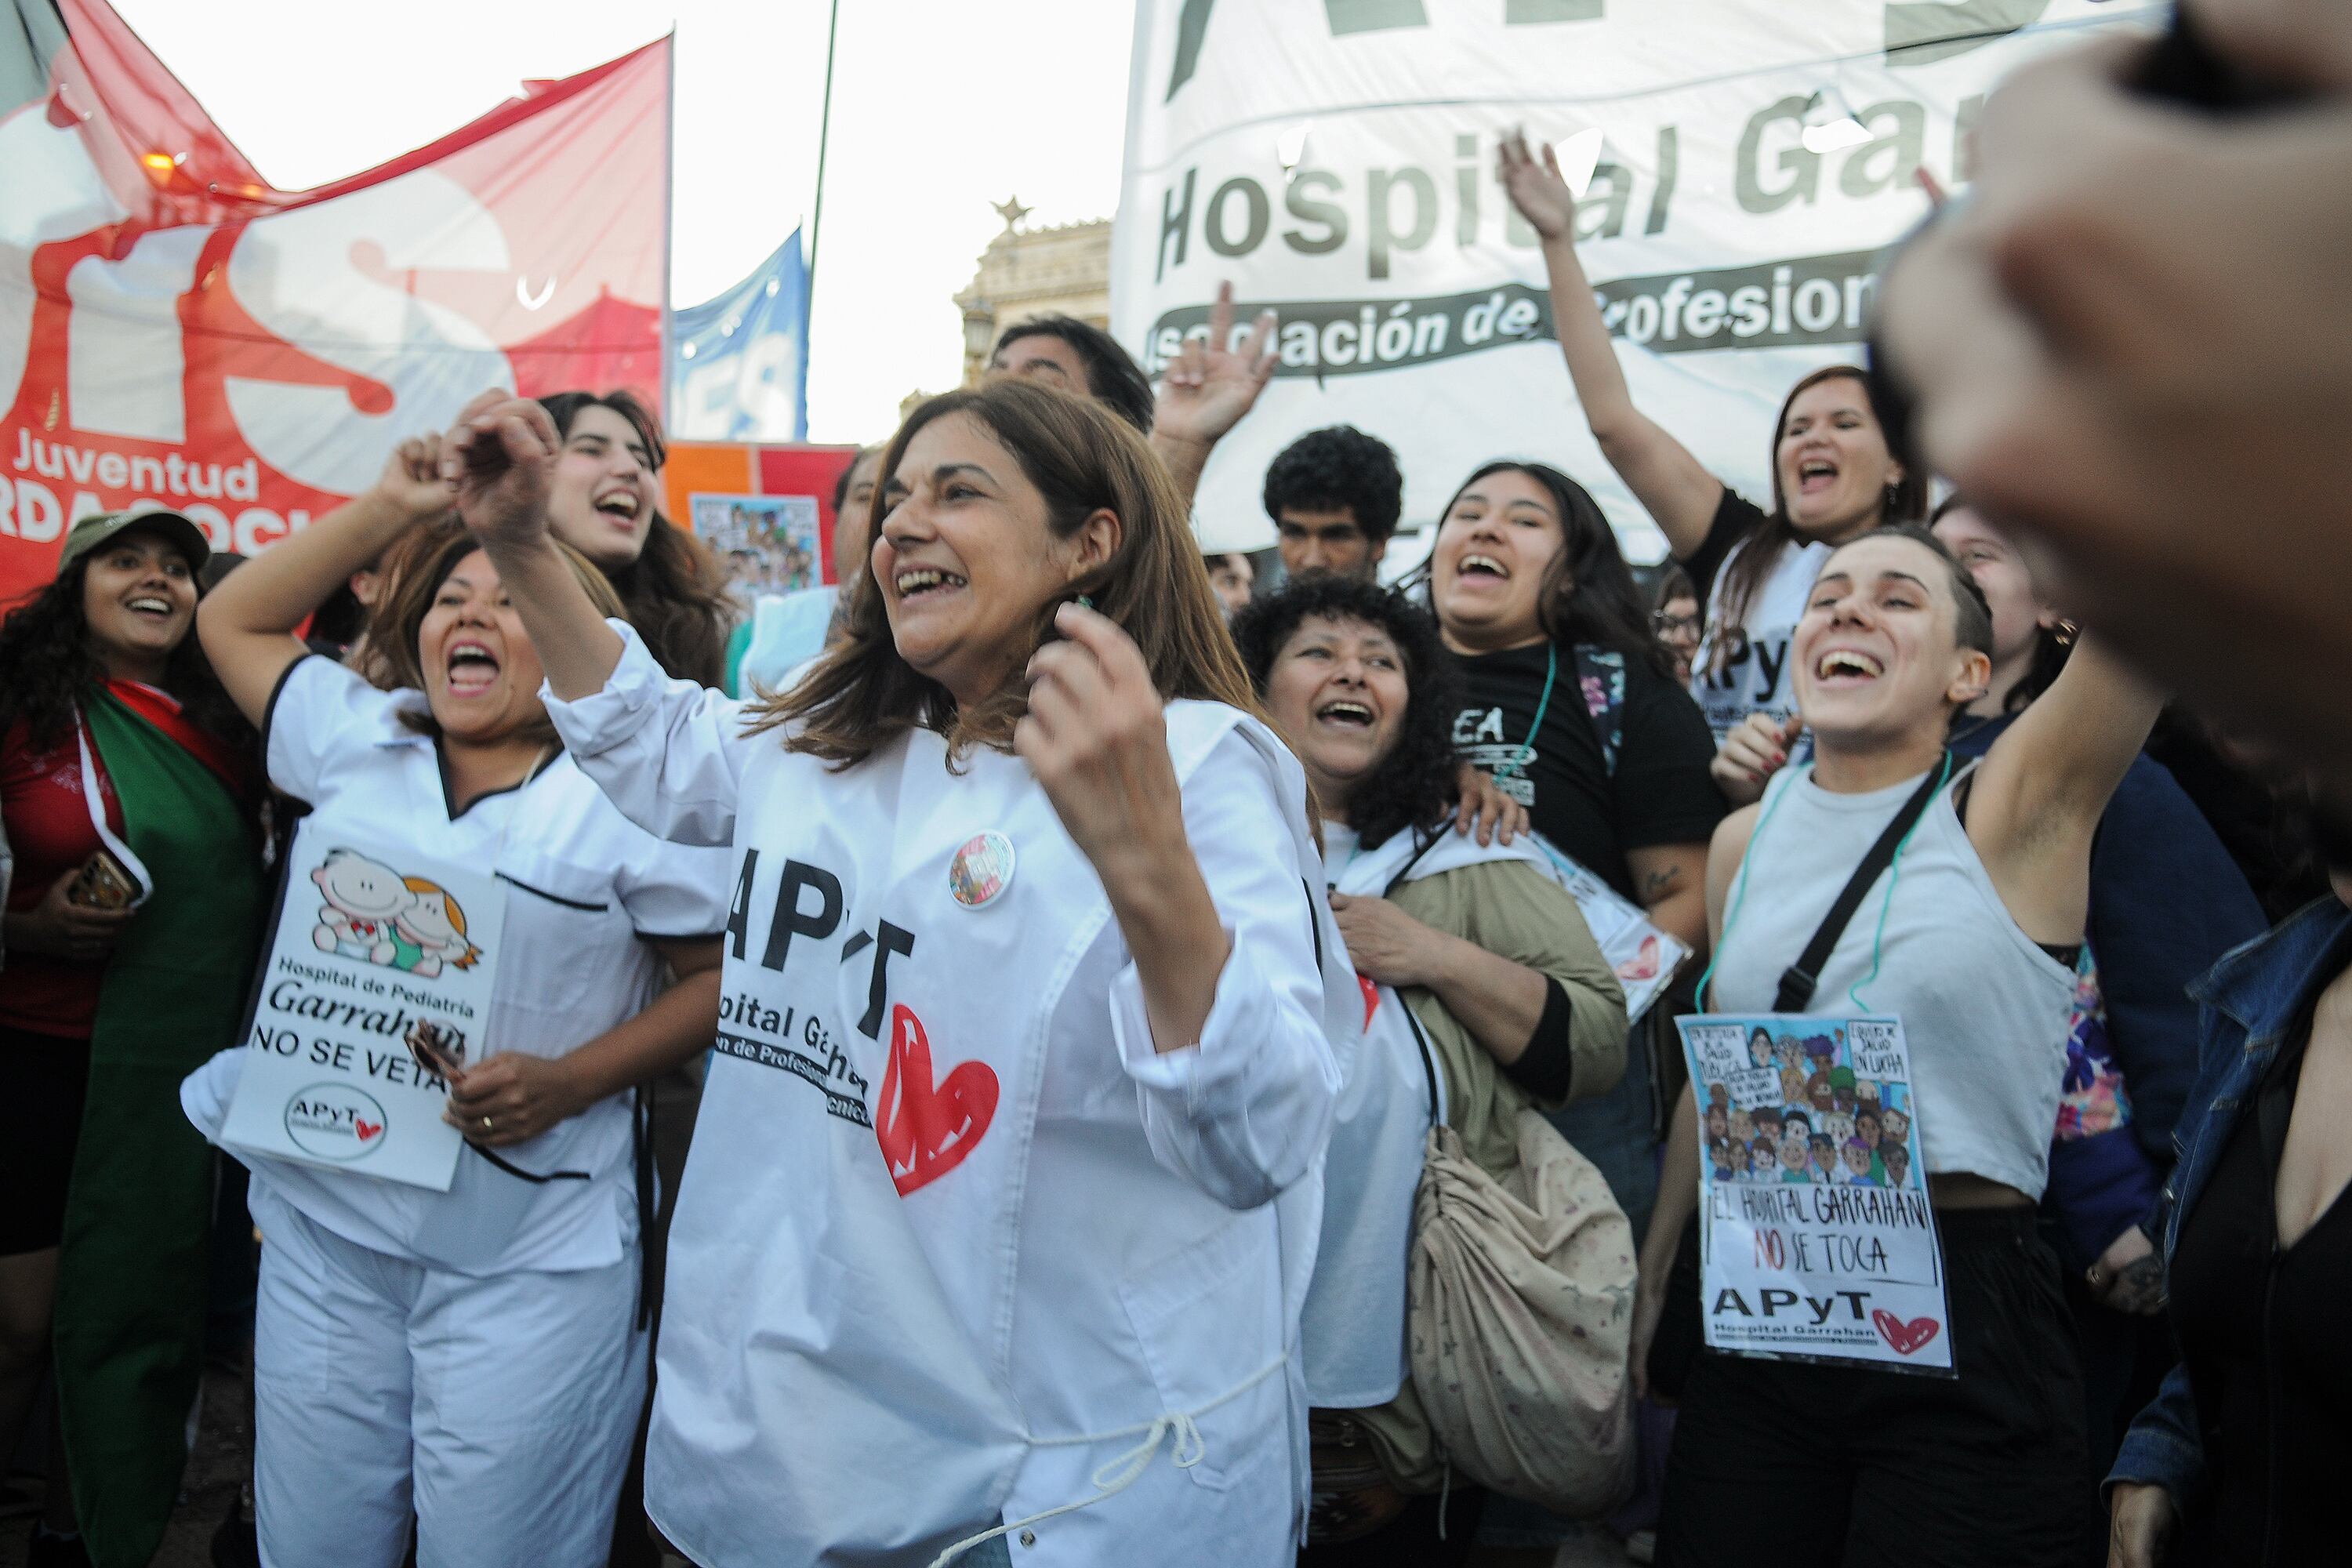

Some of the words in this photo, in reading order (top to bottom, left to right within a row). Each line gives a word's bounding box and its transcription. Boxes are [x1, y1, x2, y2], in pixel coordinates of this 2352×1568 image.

[1156, 125, 1677, 283] Hospial
[1461, 290, 1540, 346] de
[1593, 266, 1878, 344] rofesion
[13, 426, 260, 502] Juventud
[278, 956, 356, 989] Hospital
[363, 978, 386, 995] de
[252, 1023, 299, 1057] NO
[310, 1038, 355, 1072] SE
[366, 1048, 447, 1094] VETA
[733, 1040, 757, 1058] de
[293, 1098, 359, 1124] APyT
[1715, 1185, 1734, 1221] EL
[1813, 1186, 1927, 1230] GARRAHAN
[1754, 1229, 1786, 1271] NO
[1791, 1232, 1814, 1272] SE
[1817, 1233, 1889, 1274] TOCA
[1712, 1287, 1871, 1326] APyT
[1714, 1323, 1788, 1335] Hospital
[1794, 1325, 1876, 1338] Garrahan
